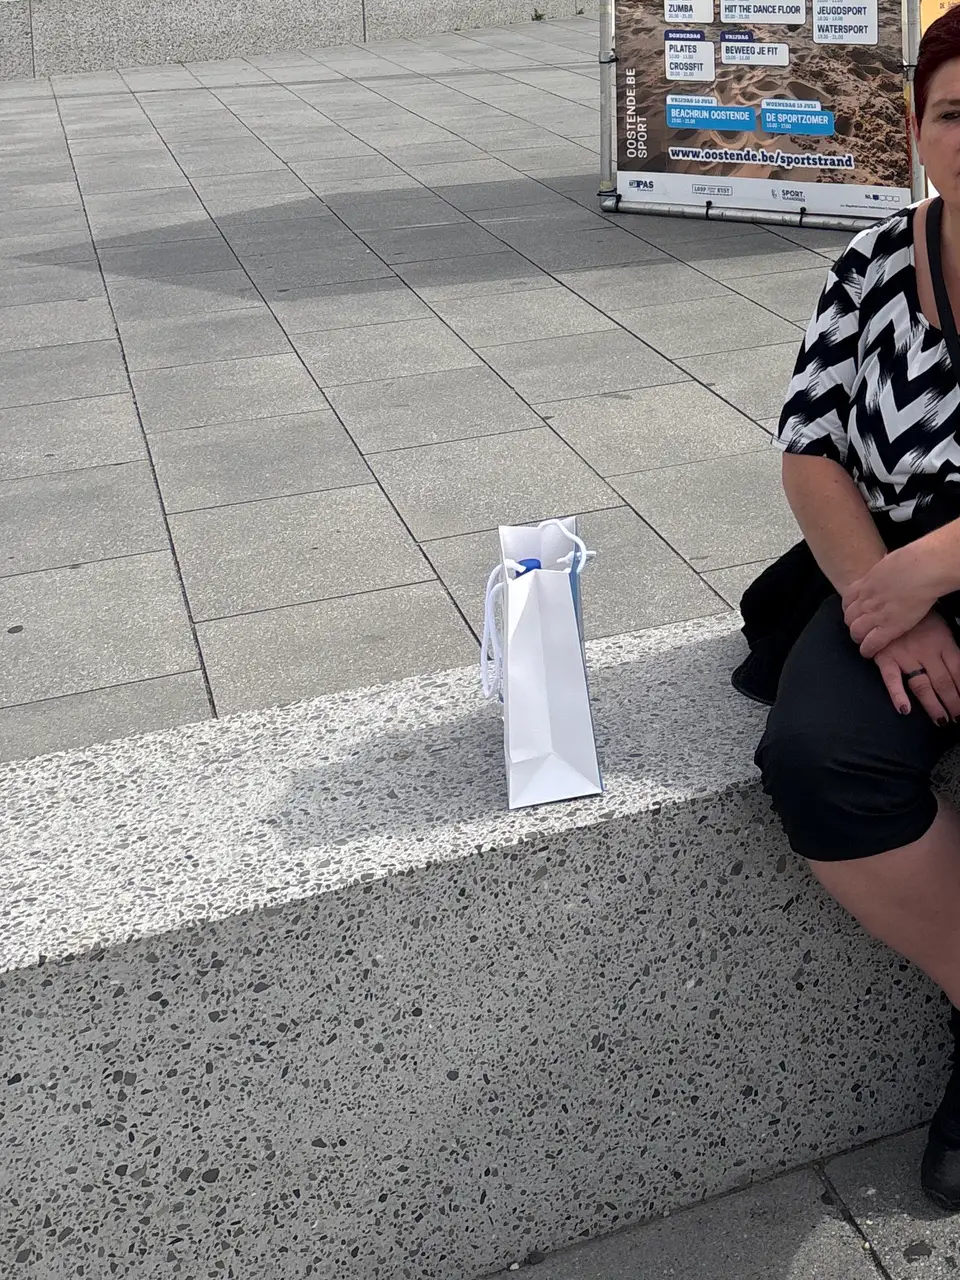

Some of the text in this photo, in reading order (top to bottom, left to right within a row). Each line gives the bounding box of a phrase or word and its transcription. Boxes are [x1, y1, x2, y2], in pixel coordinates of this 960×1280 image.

[668, 5, 693, 13] ZUMBA
[739, 5, 751, 13] THE
[753, 6, 776, 14] DANCE
[778, 6, 800, 14] FLOOR
[817, 7, 867, 15] JEUGDSPORT
[818, 25, 868, 33] WATERSPORT
[669, 45, 696, 53] PILATES
[725, 46, 778, 55] BEWEEG JE FIT
[670, 63, 703, 71] CROSSFIT
[626, 68, 636, 158] OOSTENDE.BE
[671, 109, 749, 120] BEACHRUN OOSTENDE
[766, 113, 828, 124] DE SPORTZOMER
[637, 115, 647, 158] SPORT
[671, 148, 853, 168] www.oostende.be/sportstrand
